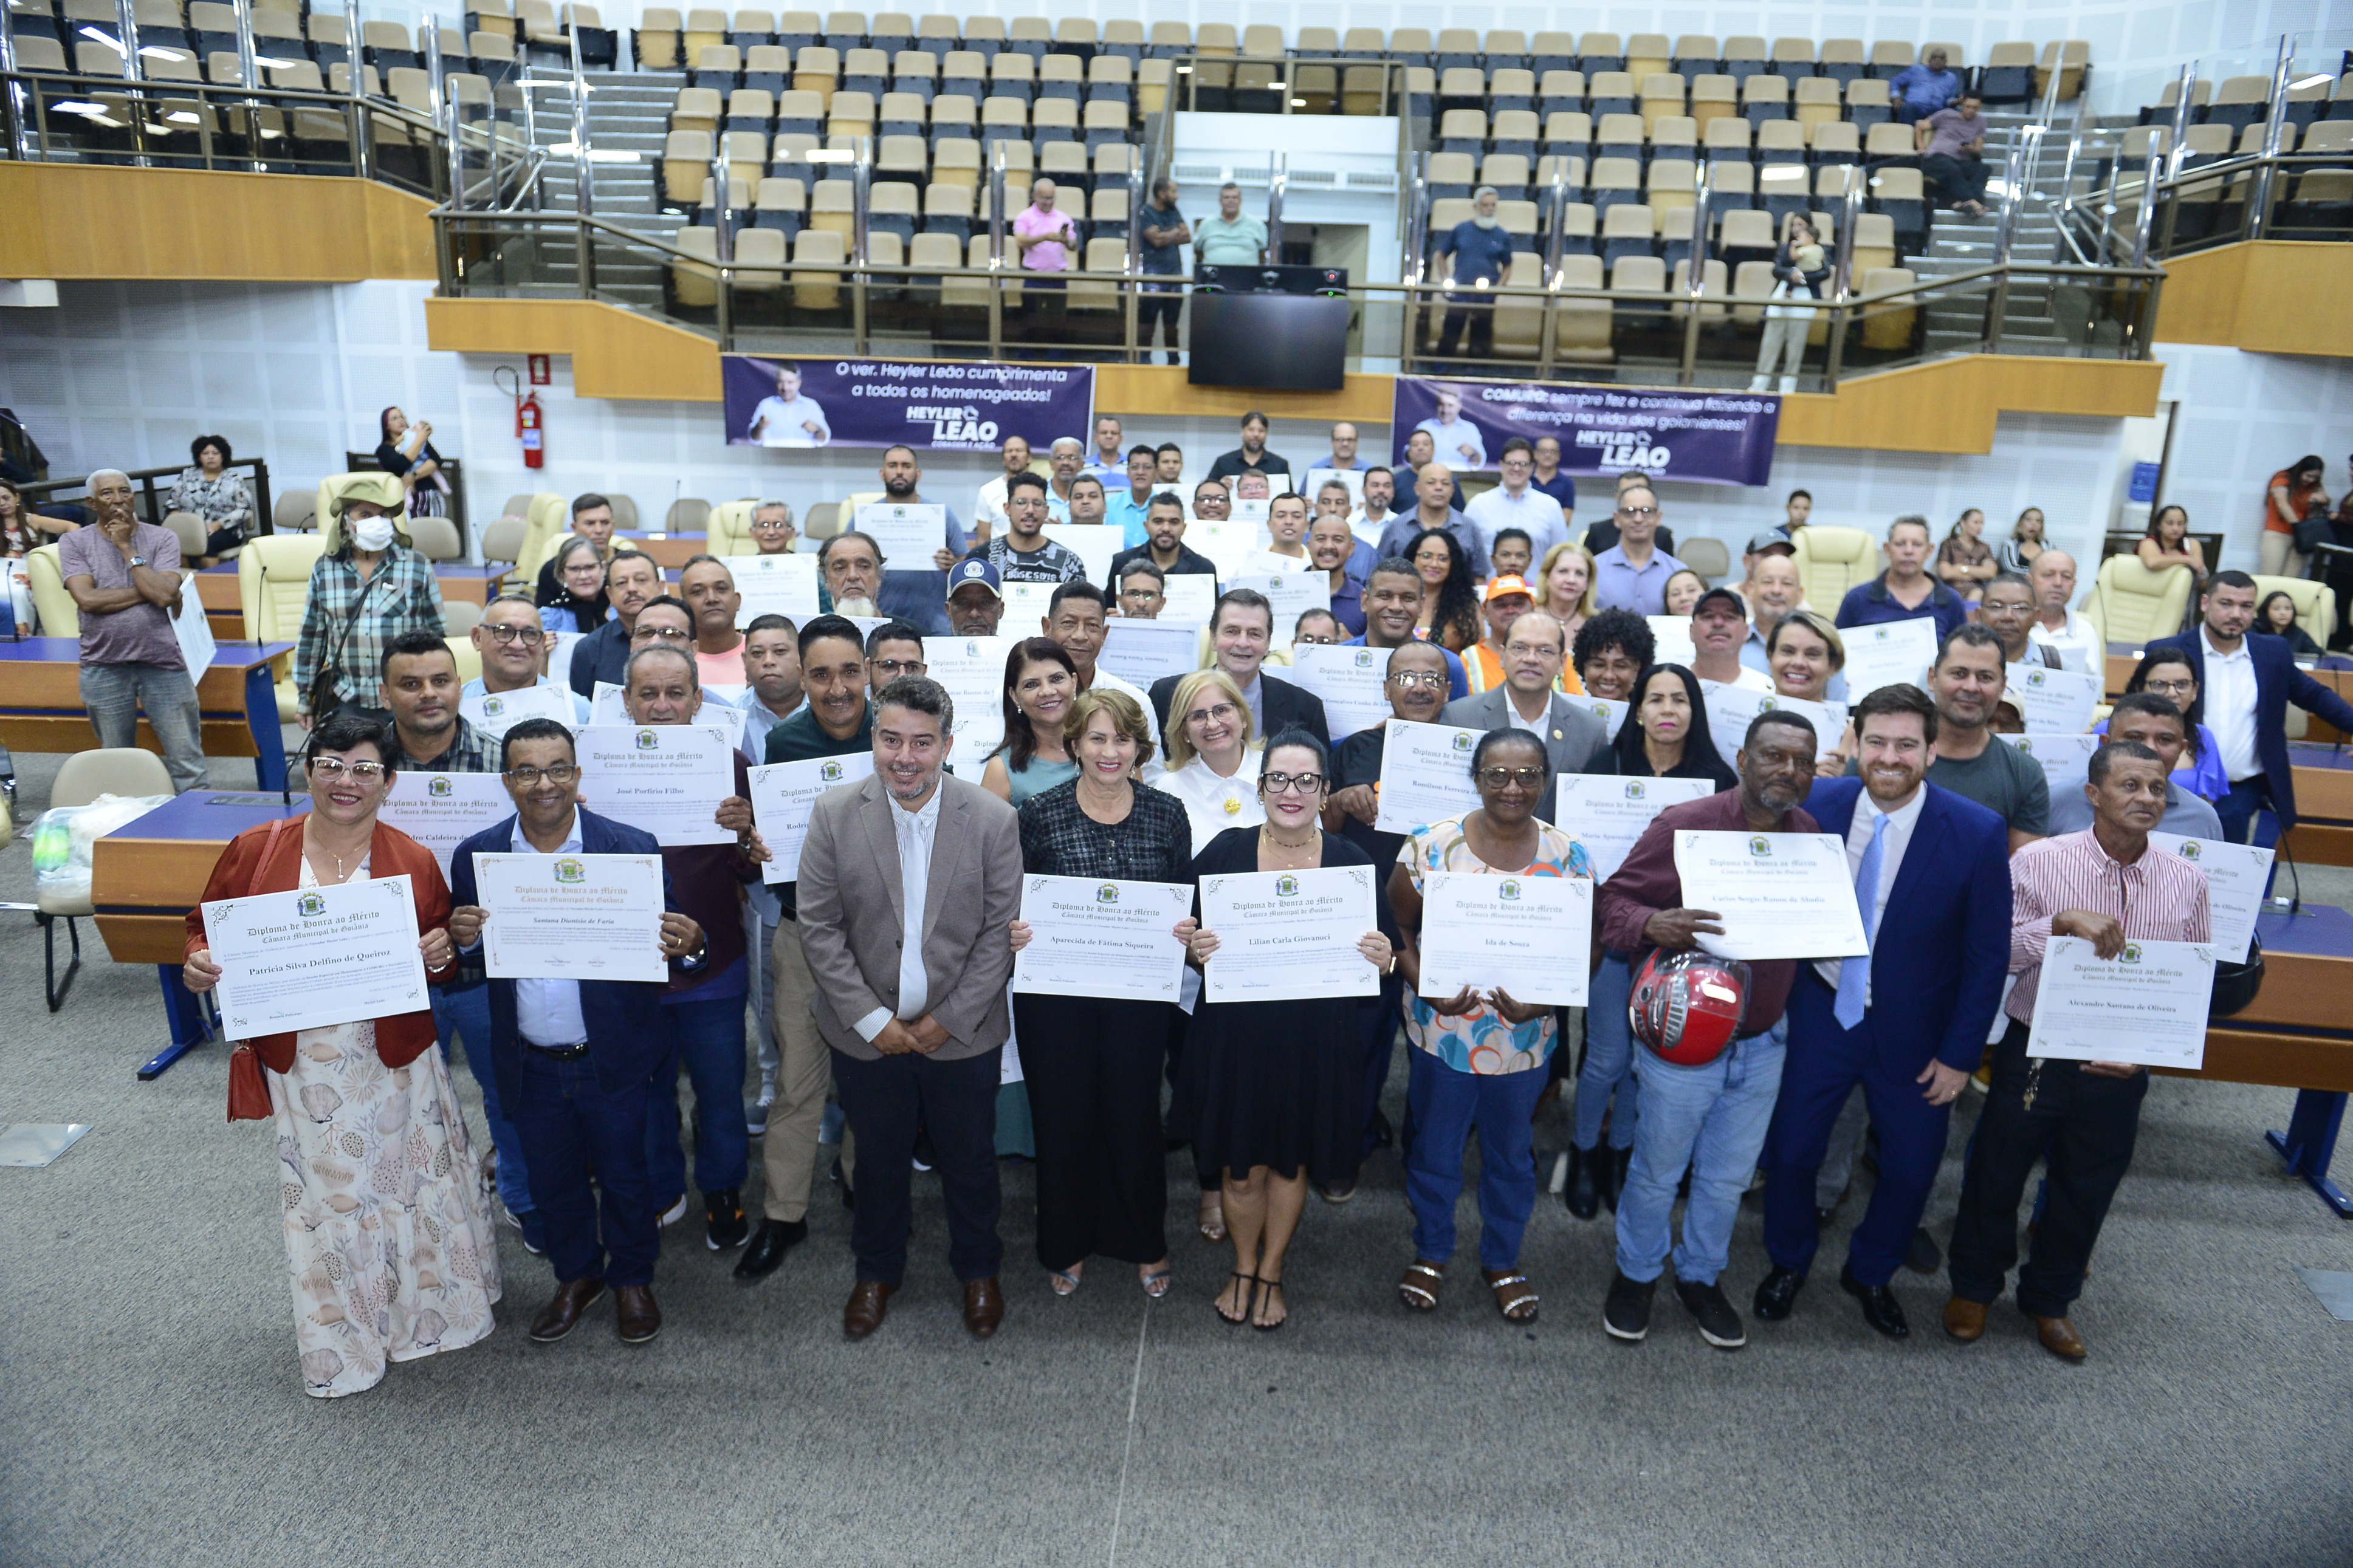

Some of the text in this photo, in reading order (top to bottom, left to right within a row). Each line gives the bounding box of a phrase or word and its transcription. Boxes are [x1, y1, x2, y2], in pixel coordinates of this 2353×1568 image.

[836, 362, 1067, 383] O ver. Heyler Leão cumprimenta
[851, 384, 1051, 403] a todos os homenageados!
[1549, 393, 1604, 408] sempre
[1605, 393, 1626, 408] faz
[1640, 397, 1704, 410] continua
[906, 406, 963, 419] HEYLER
[1574, 413, 1595, 425] na
[1596, 412, 1627, 426] vida
[1628, 414, 1657, 428] dos
[1576, 430, 1635, 445] HEYLER
[1412, 748, 1441, 758] Diploma
[780, 789, 812, 798] Diploma
[1412, 781, 1443, 790] Romilson
[1444, 786, 1469, 794] Ferreira
[1052, 902, 1084, 911] Diploma
[1456, 900, 1488, 909] Diploma
[247, 926, 287, 936] Diploma
[303, 919, 332, 928] Honra
[349, 912, 379, 922] Mérito
[262, 936, 290, 944] Câmara
[294, 929, 329, 940] Municipal
[249, 965, 283, 976] Patrícia
[310, 958, 344, 967] Delfino
[357, 950, 391, 960] Queiroz
[2074, 964, 2105, 973] Diploma
